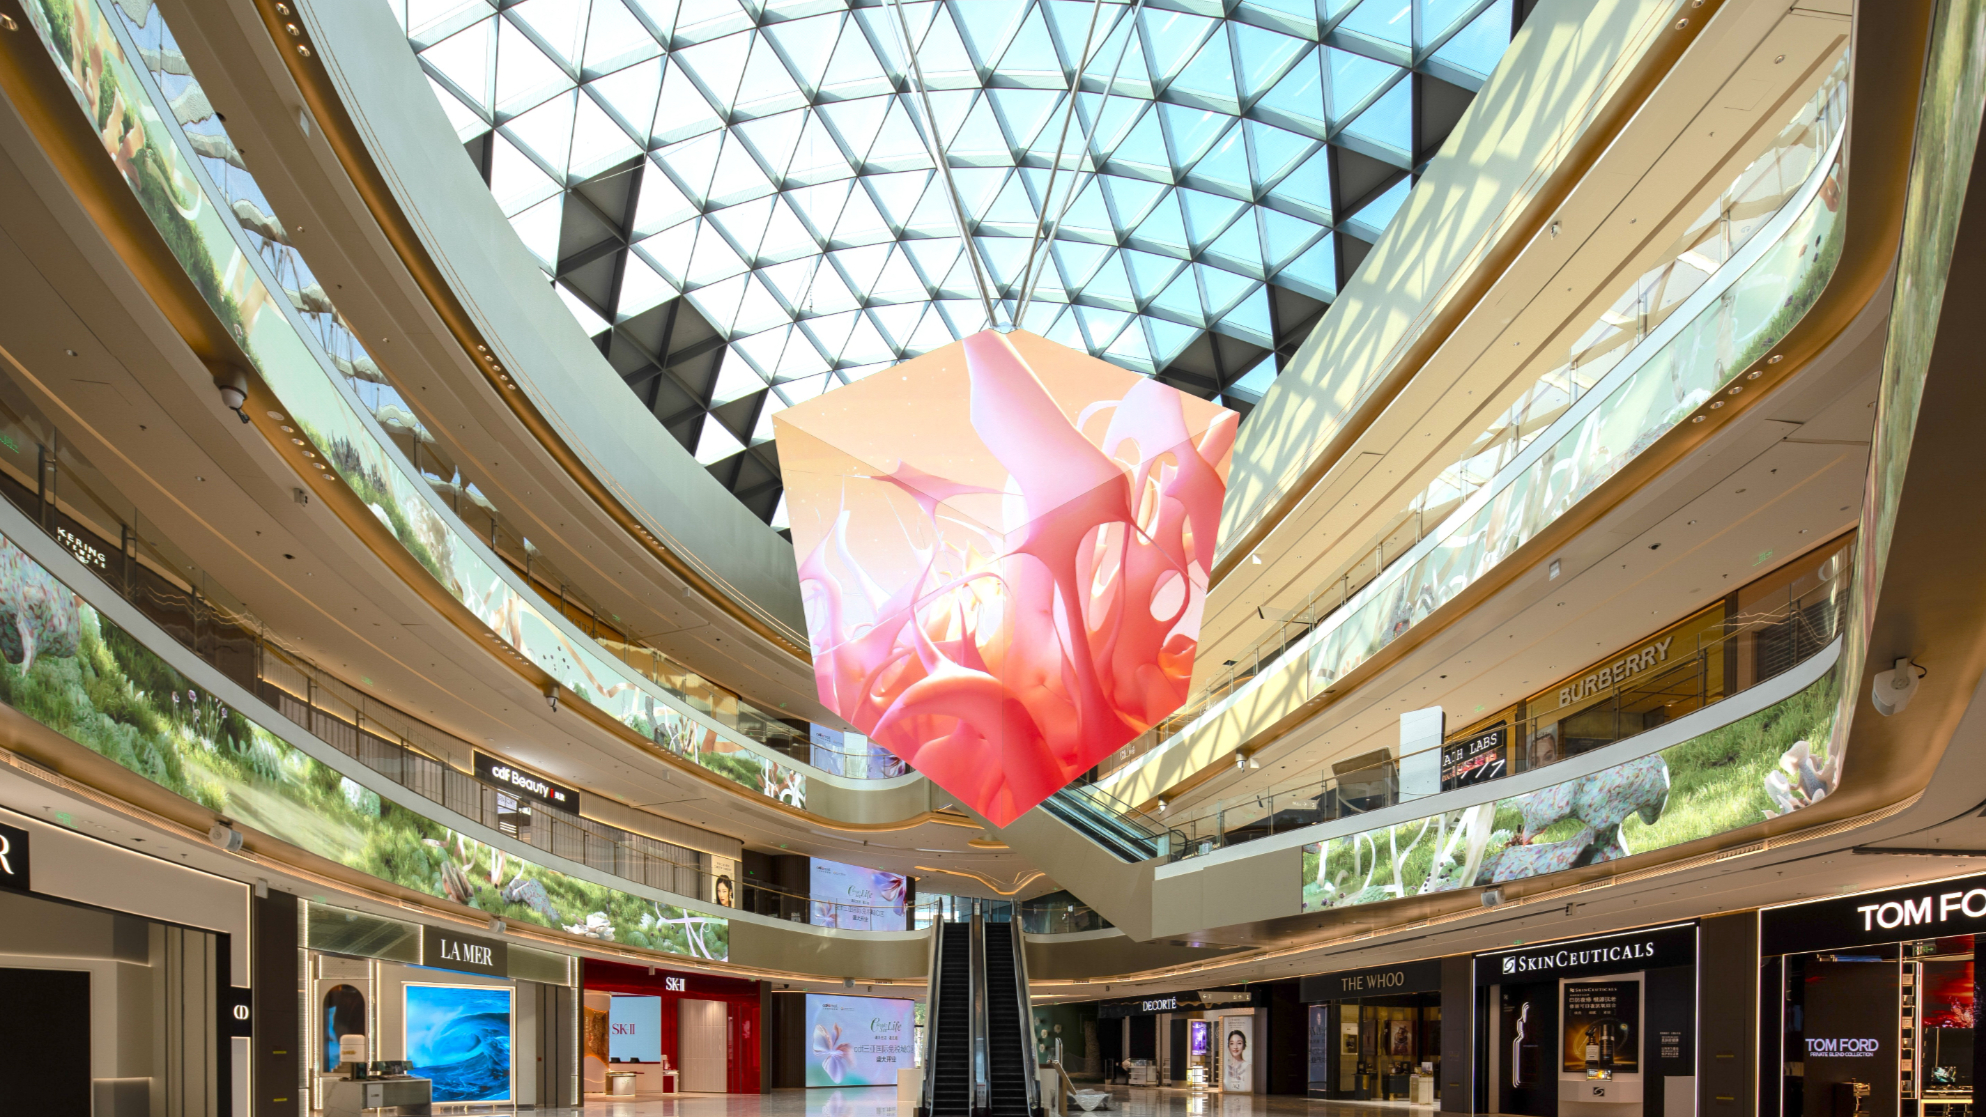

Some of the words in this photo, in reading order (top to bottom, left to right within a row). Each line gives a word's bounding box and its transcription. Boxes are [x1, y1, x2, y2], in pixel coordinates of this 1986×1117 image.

[57, 526, 106, 562] KERING
[1558, 635, 1674, 709] BURBERRY
[1469, 733, 1498, 755] LABS
[492, 766, 511, 781] cdf
[512, 770, 549, 798] Beauty
[1857, 896, 1932, 931] TOM
[1940, 888, 1986, 922] FO
[440, 938, 461, 961] LA
[463, 943, 493, 966] MER
[665, 976, 685, 992] SK-II
[1341, 976, 1364, 991] THE
[1366, 971, 1404, 989] WHOO
[1142, 996, 1177, 1012] DECORTÉ
[611, 1023, 635, 1035] SK-II
[1805, 1038, 1837, 1052] TOM
[1839, 1038, 1879, 1052] FORD
